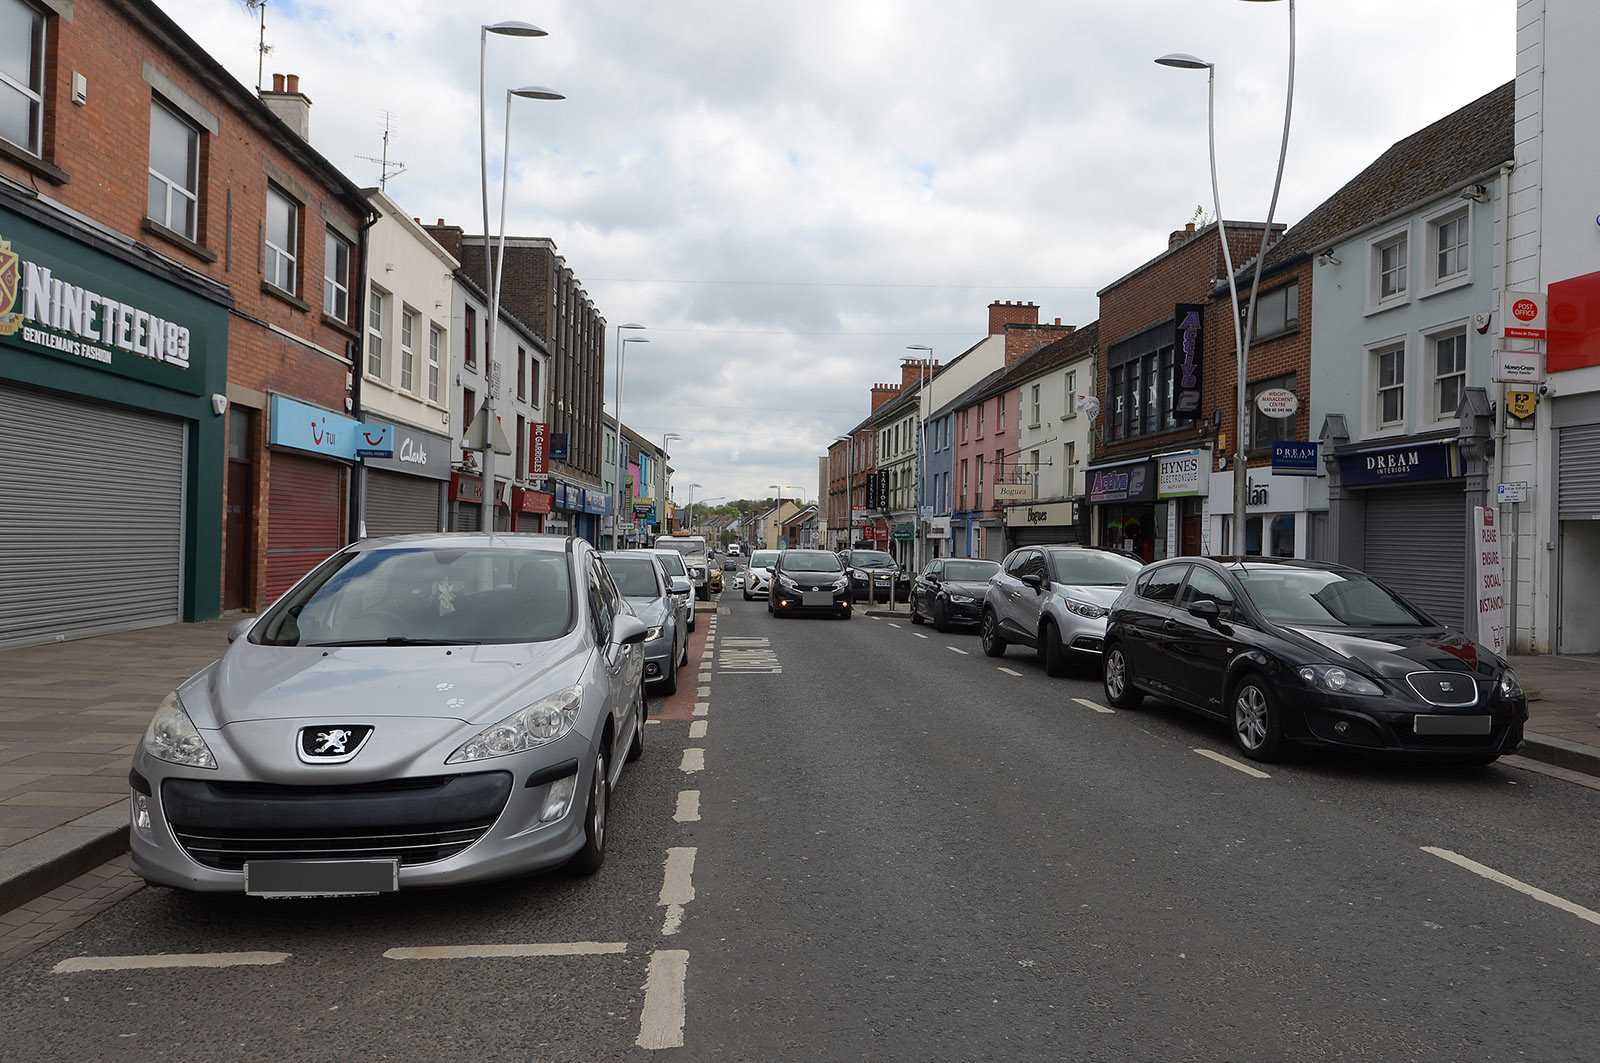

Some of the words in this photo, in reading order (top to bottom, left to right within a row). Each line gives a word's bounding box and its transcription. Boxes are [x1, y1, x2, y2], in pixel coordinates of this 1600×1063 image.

[23, 326, 81, 356] GENTLEMAN'S
[80, 342, 112, 364] FASHION
[1177, 311, 1201, 388] Active
[1504, 364, 1535, 372] MoneyGram
[1175, 390, 1201, 412] 2
[326, 431, 336, 446] TUI
[399, 437, 427, 465] Clarks
[534, 436, 544, 473] GARRIGLES
[1276, 448, 1315, 457] DREAM
[1160, 458, 1198, 475] HYNES
[1366, 451, 1419, 470] DREAM
[1160, 472, 1198, 484] ELECTRONIQUE
[1376, 465, 1411, 475] INTERIORS
[1091, 470, 1129, 495] Active
[1129, 467, 1147, 496] 2
[1000, 488, 1027, 496] Bogues
[1027, 508, 1047, 525] Bogues
[1482, 529, 1497, 542] PLEASE
[1482, 552, 1499, 566] ENSURE
[1483, 574, 1501, 589] SOCIAL
